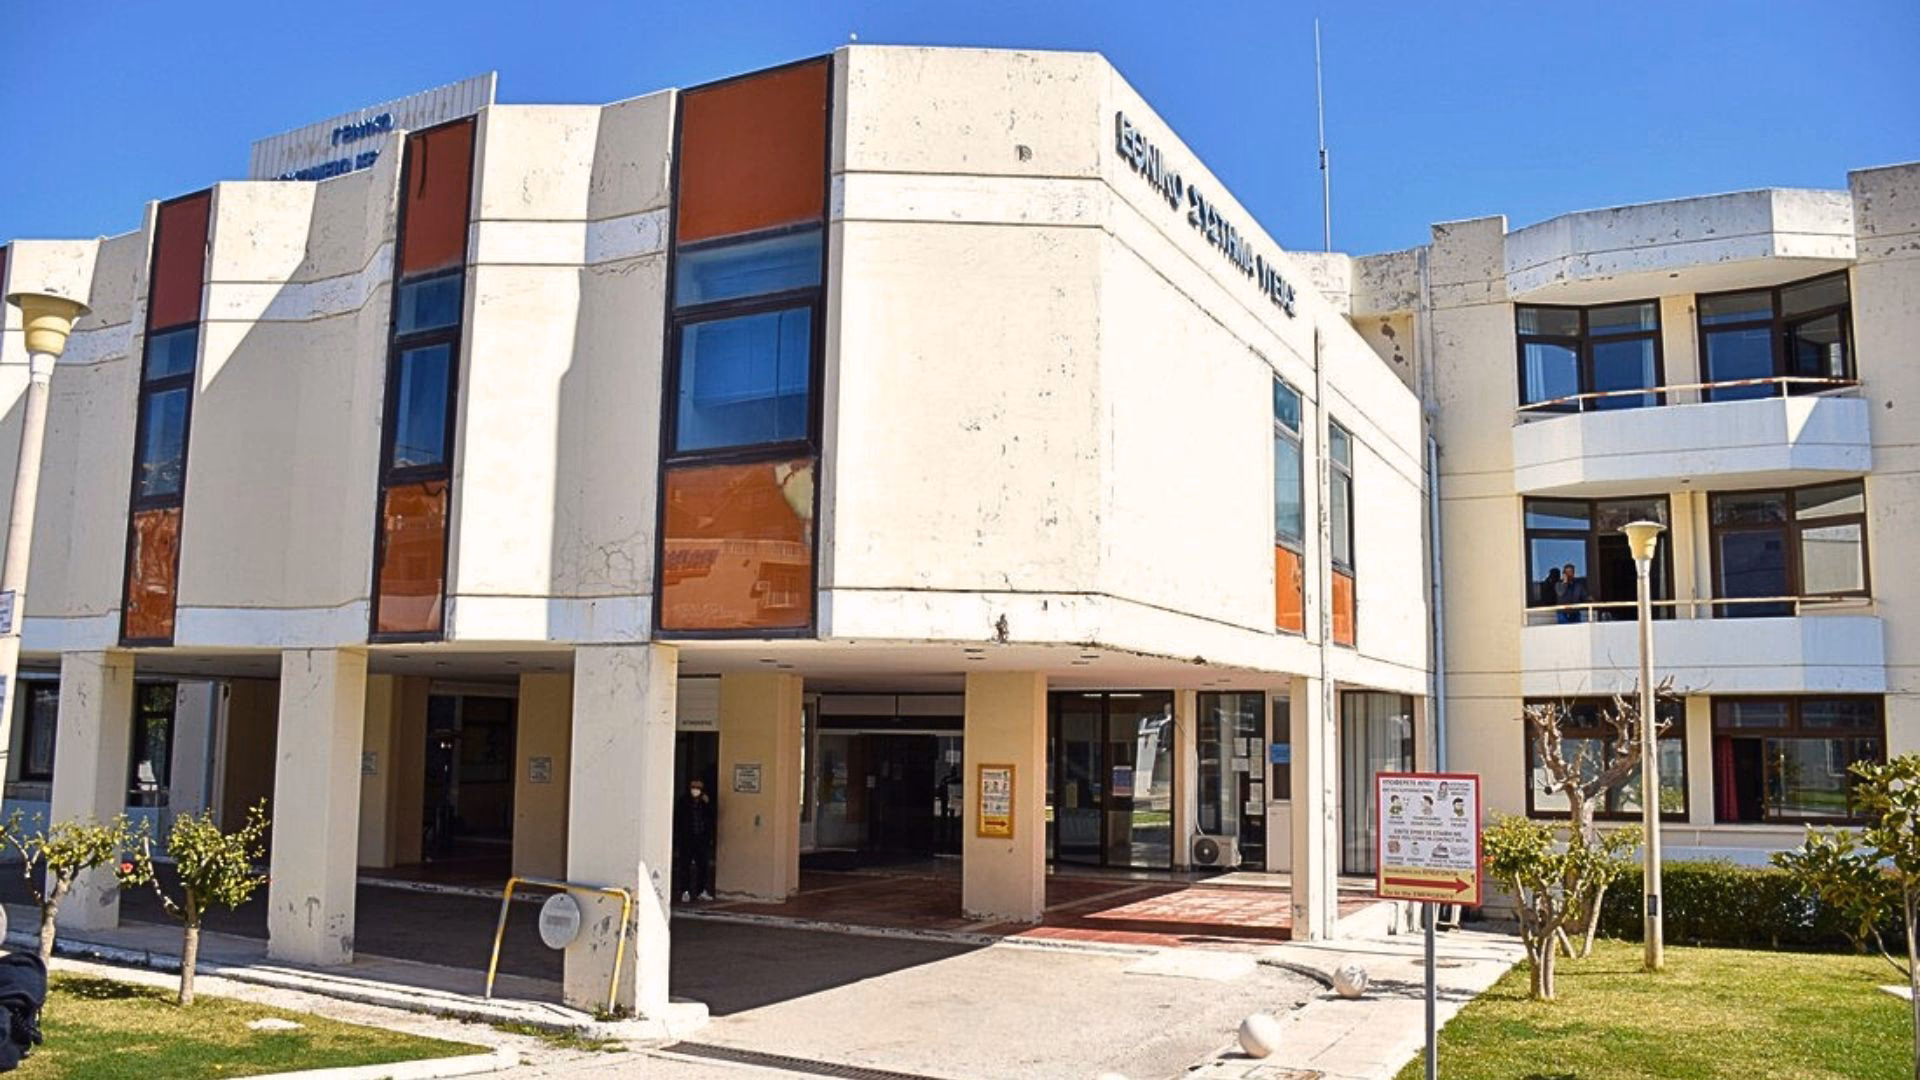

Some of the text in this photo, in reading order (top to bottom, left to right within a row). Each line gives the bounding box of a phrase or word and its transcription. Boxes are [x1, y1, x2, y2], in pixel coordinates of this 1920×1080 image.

[331, 113, 394, 147] ΓΕΝΙΚΟ
[1115, 111, 1183, 212] ΕΘΝΙΚΟ
[1187, 184, 1254, 281] ΣΥΣΤΗΜΑ
